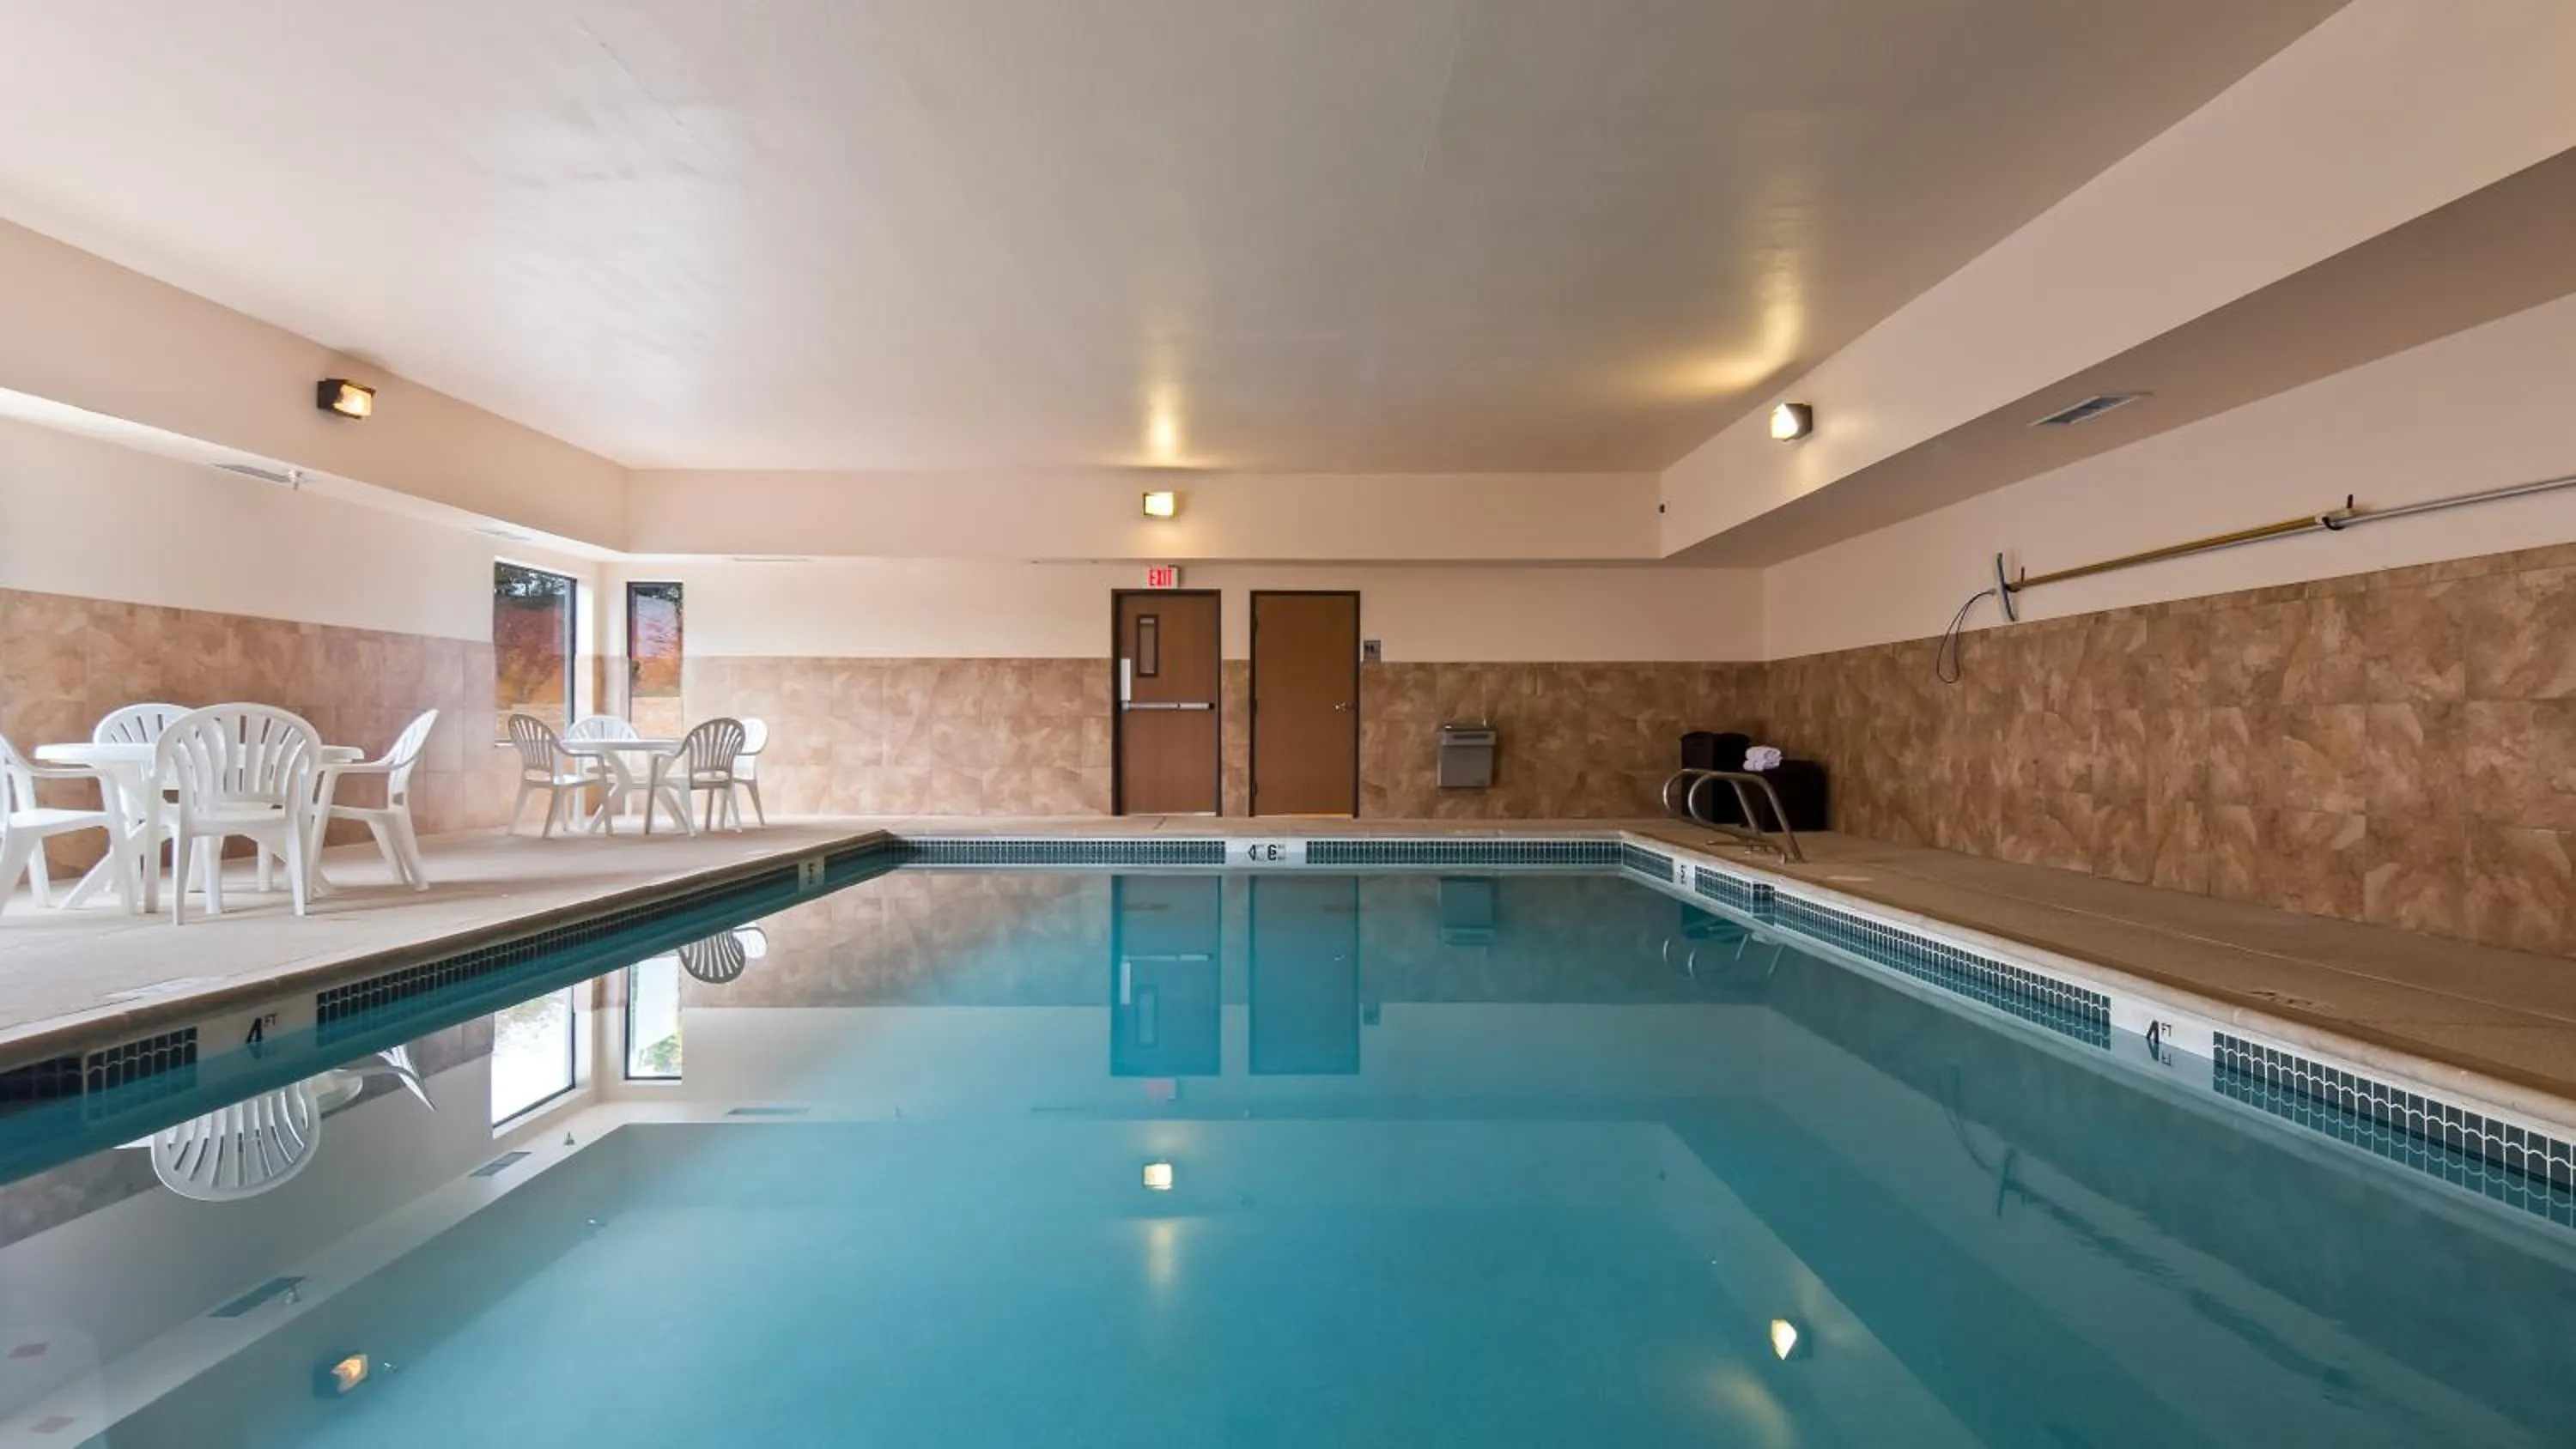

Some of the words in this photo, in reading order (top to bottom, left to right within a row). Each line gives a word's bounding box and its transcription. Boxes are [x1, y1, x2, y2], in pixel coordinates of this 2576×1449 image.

[1148, 568, 1174, 588] EXIT
[246, 1017, 262, 1044] 4
[2147, 1020, 2159, 1044] 4
[2161, 1022, 2172, 1038] FT
